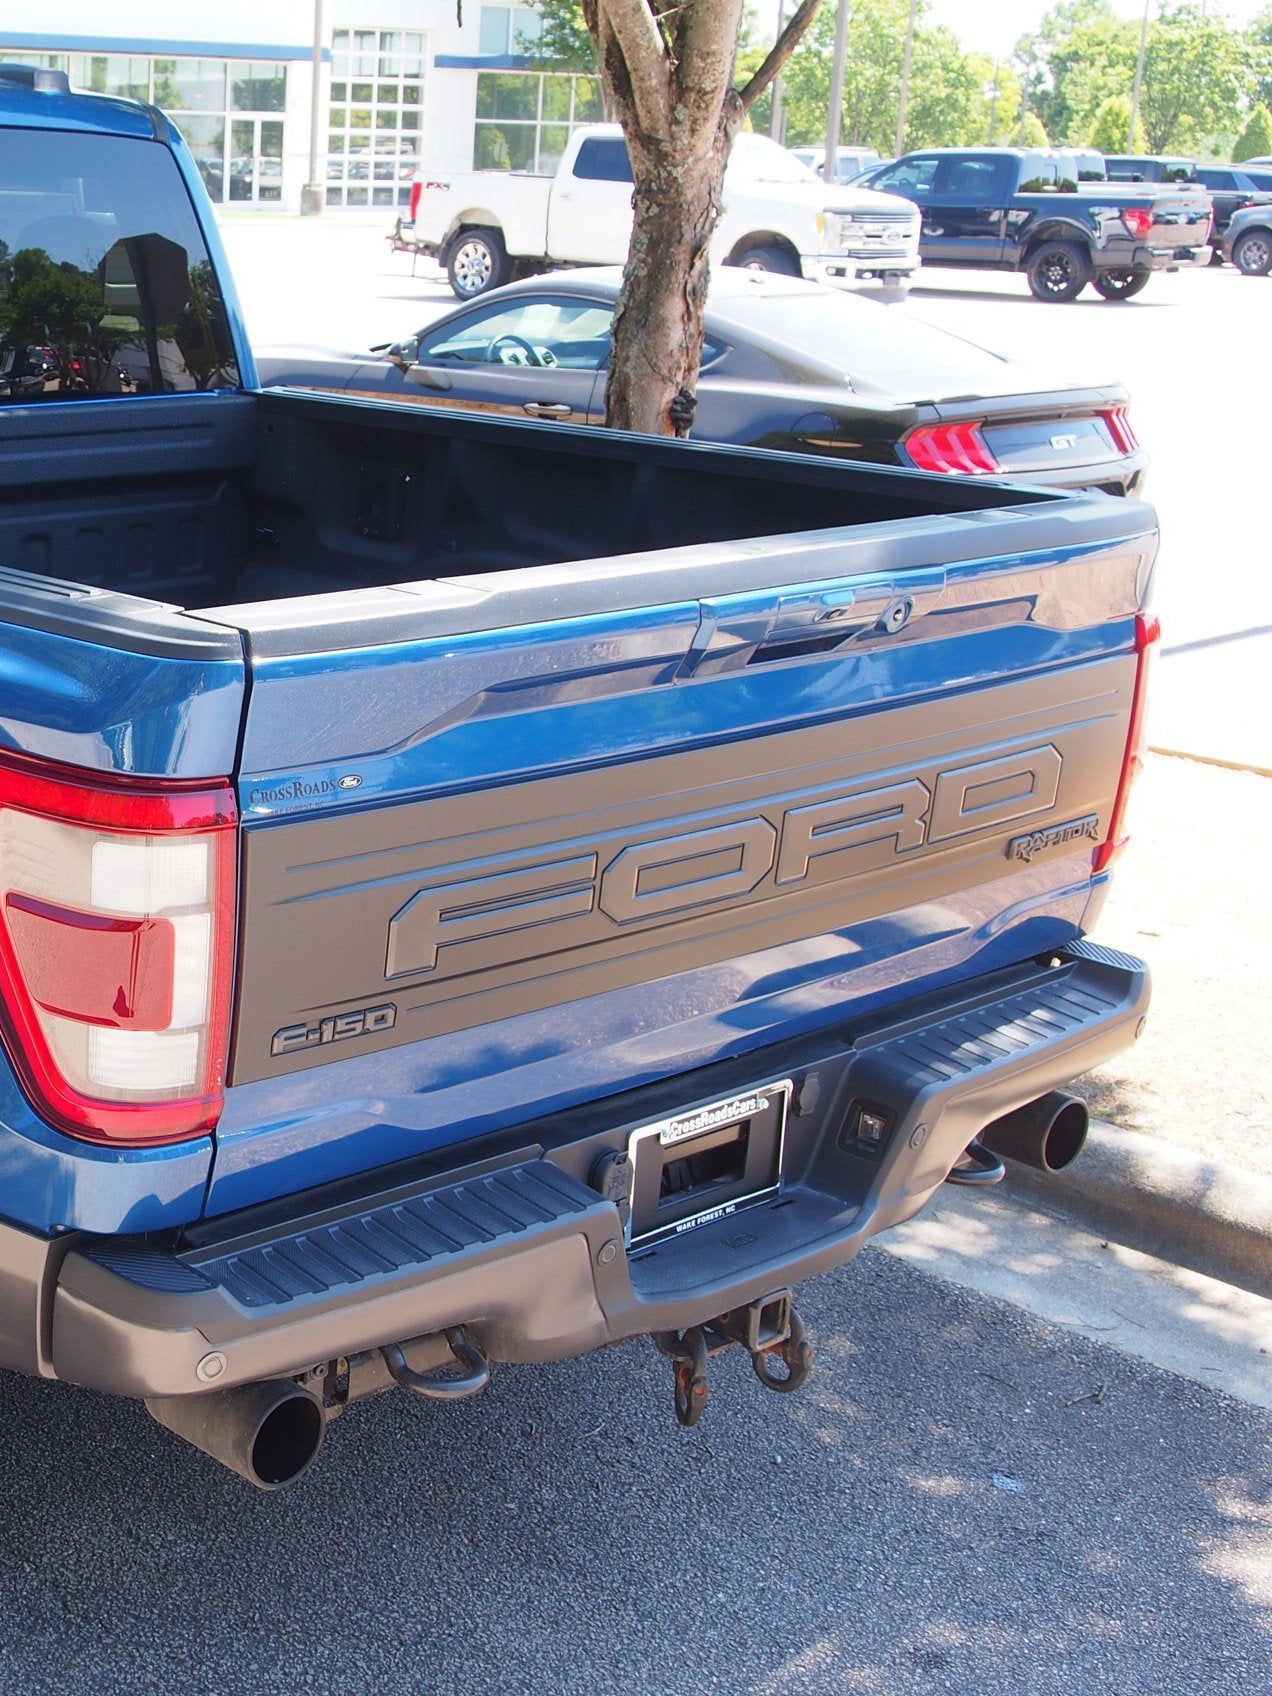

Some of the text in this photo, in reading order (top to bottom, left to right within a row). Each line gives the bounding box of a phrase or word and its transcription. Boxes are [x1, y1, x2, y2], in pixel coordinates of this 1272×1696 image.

[1049, 434, 1077, 450] GT
[1004, 812, 1100, 863] RAPTOR
[384, 743, 1064, 981] FORD
[270, 1002, 397, 1057] F-150
[670, 1098, 756, 1137] CrossRoadsCars
[676, 1205, 736, 1232] WAKE FOREST, NC
